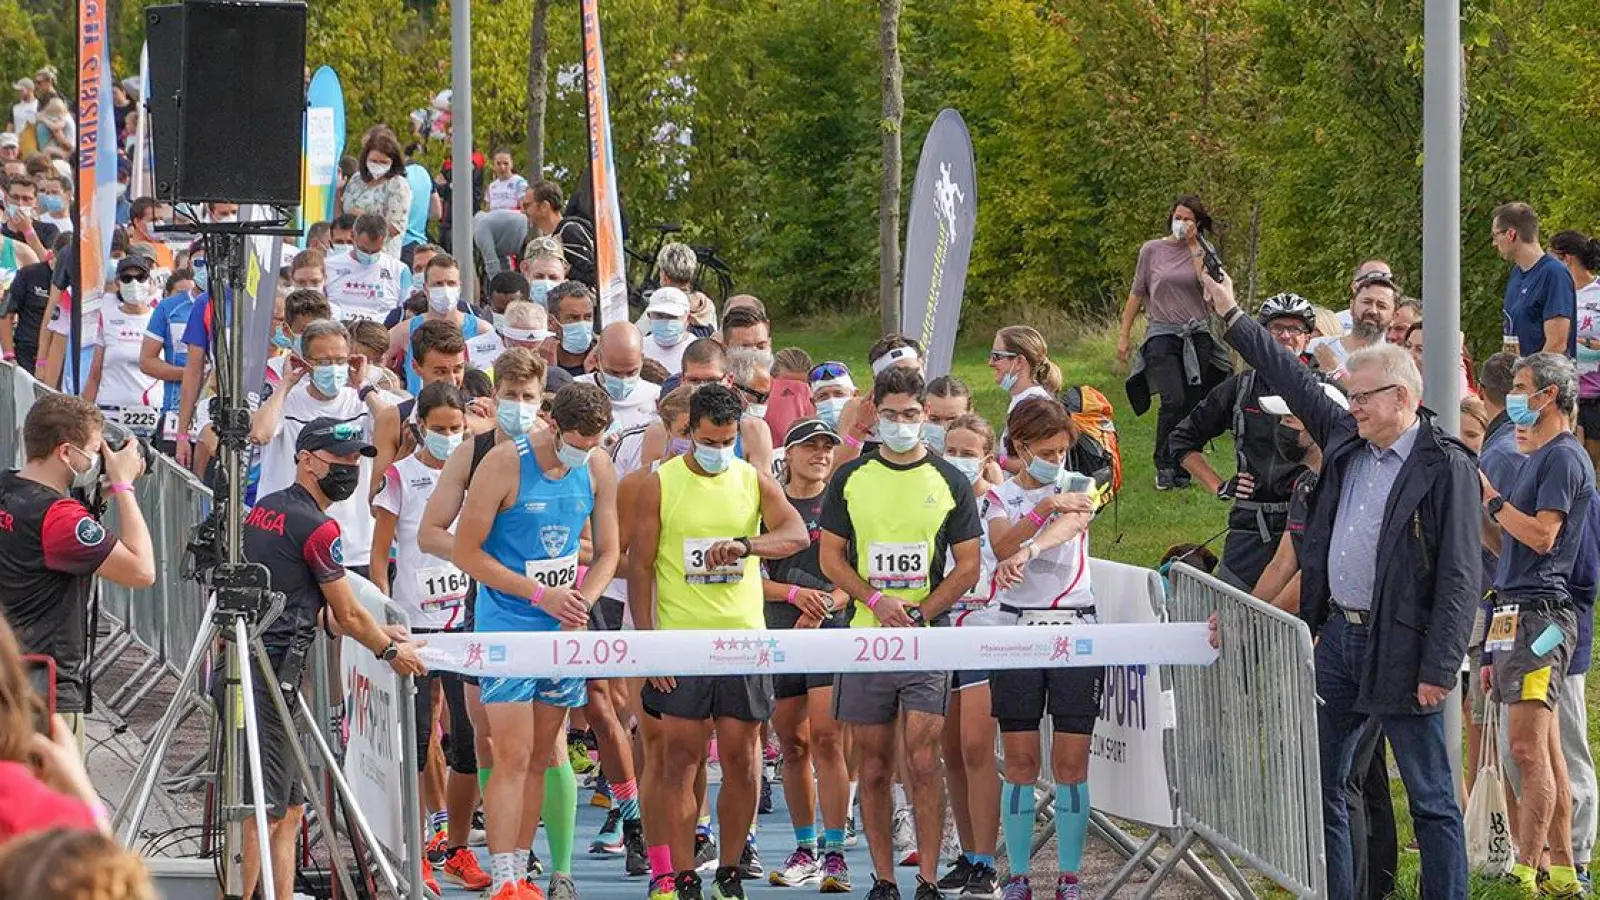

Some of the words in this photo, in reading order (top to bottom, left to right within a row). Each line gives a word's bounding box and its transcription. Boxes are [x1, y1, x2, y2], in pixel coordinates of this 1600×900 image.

[123, 412, 156, 425] 2225
[875, 553, 921, 572] 1163
[426, 573, 467, 595] 1164
[535, 565, 575, 587] 3026
[552, 639, 637, 665] 12.09.
[854, 636, 919, 661] 2021
